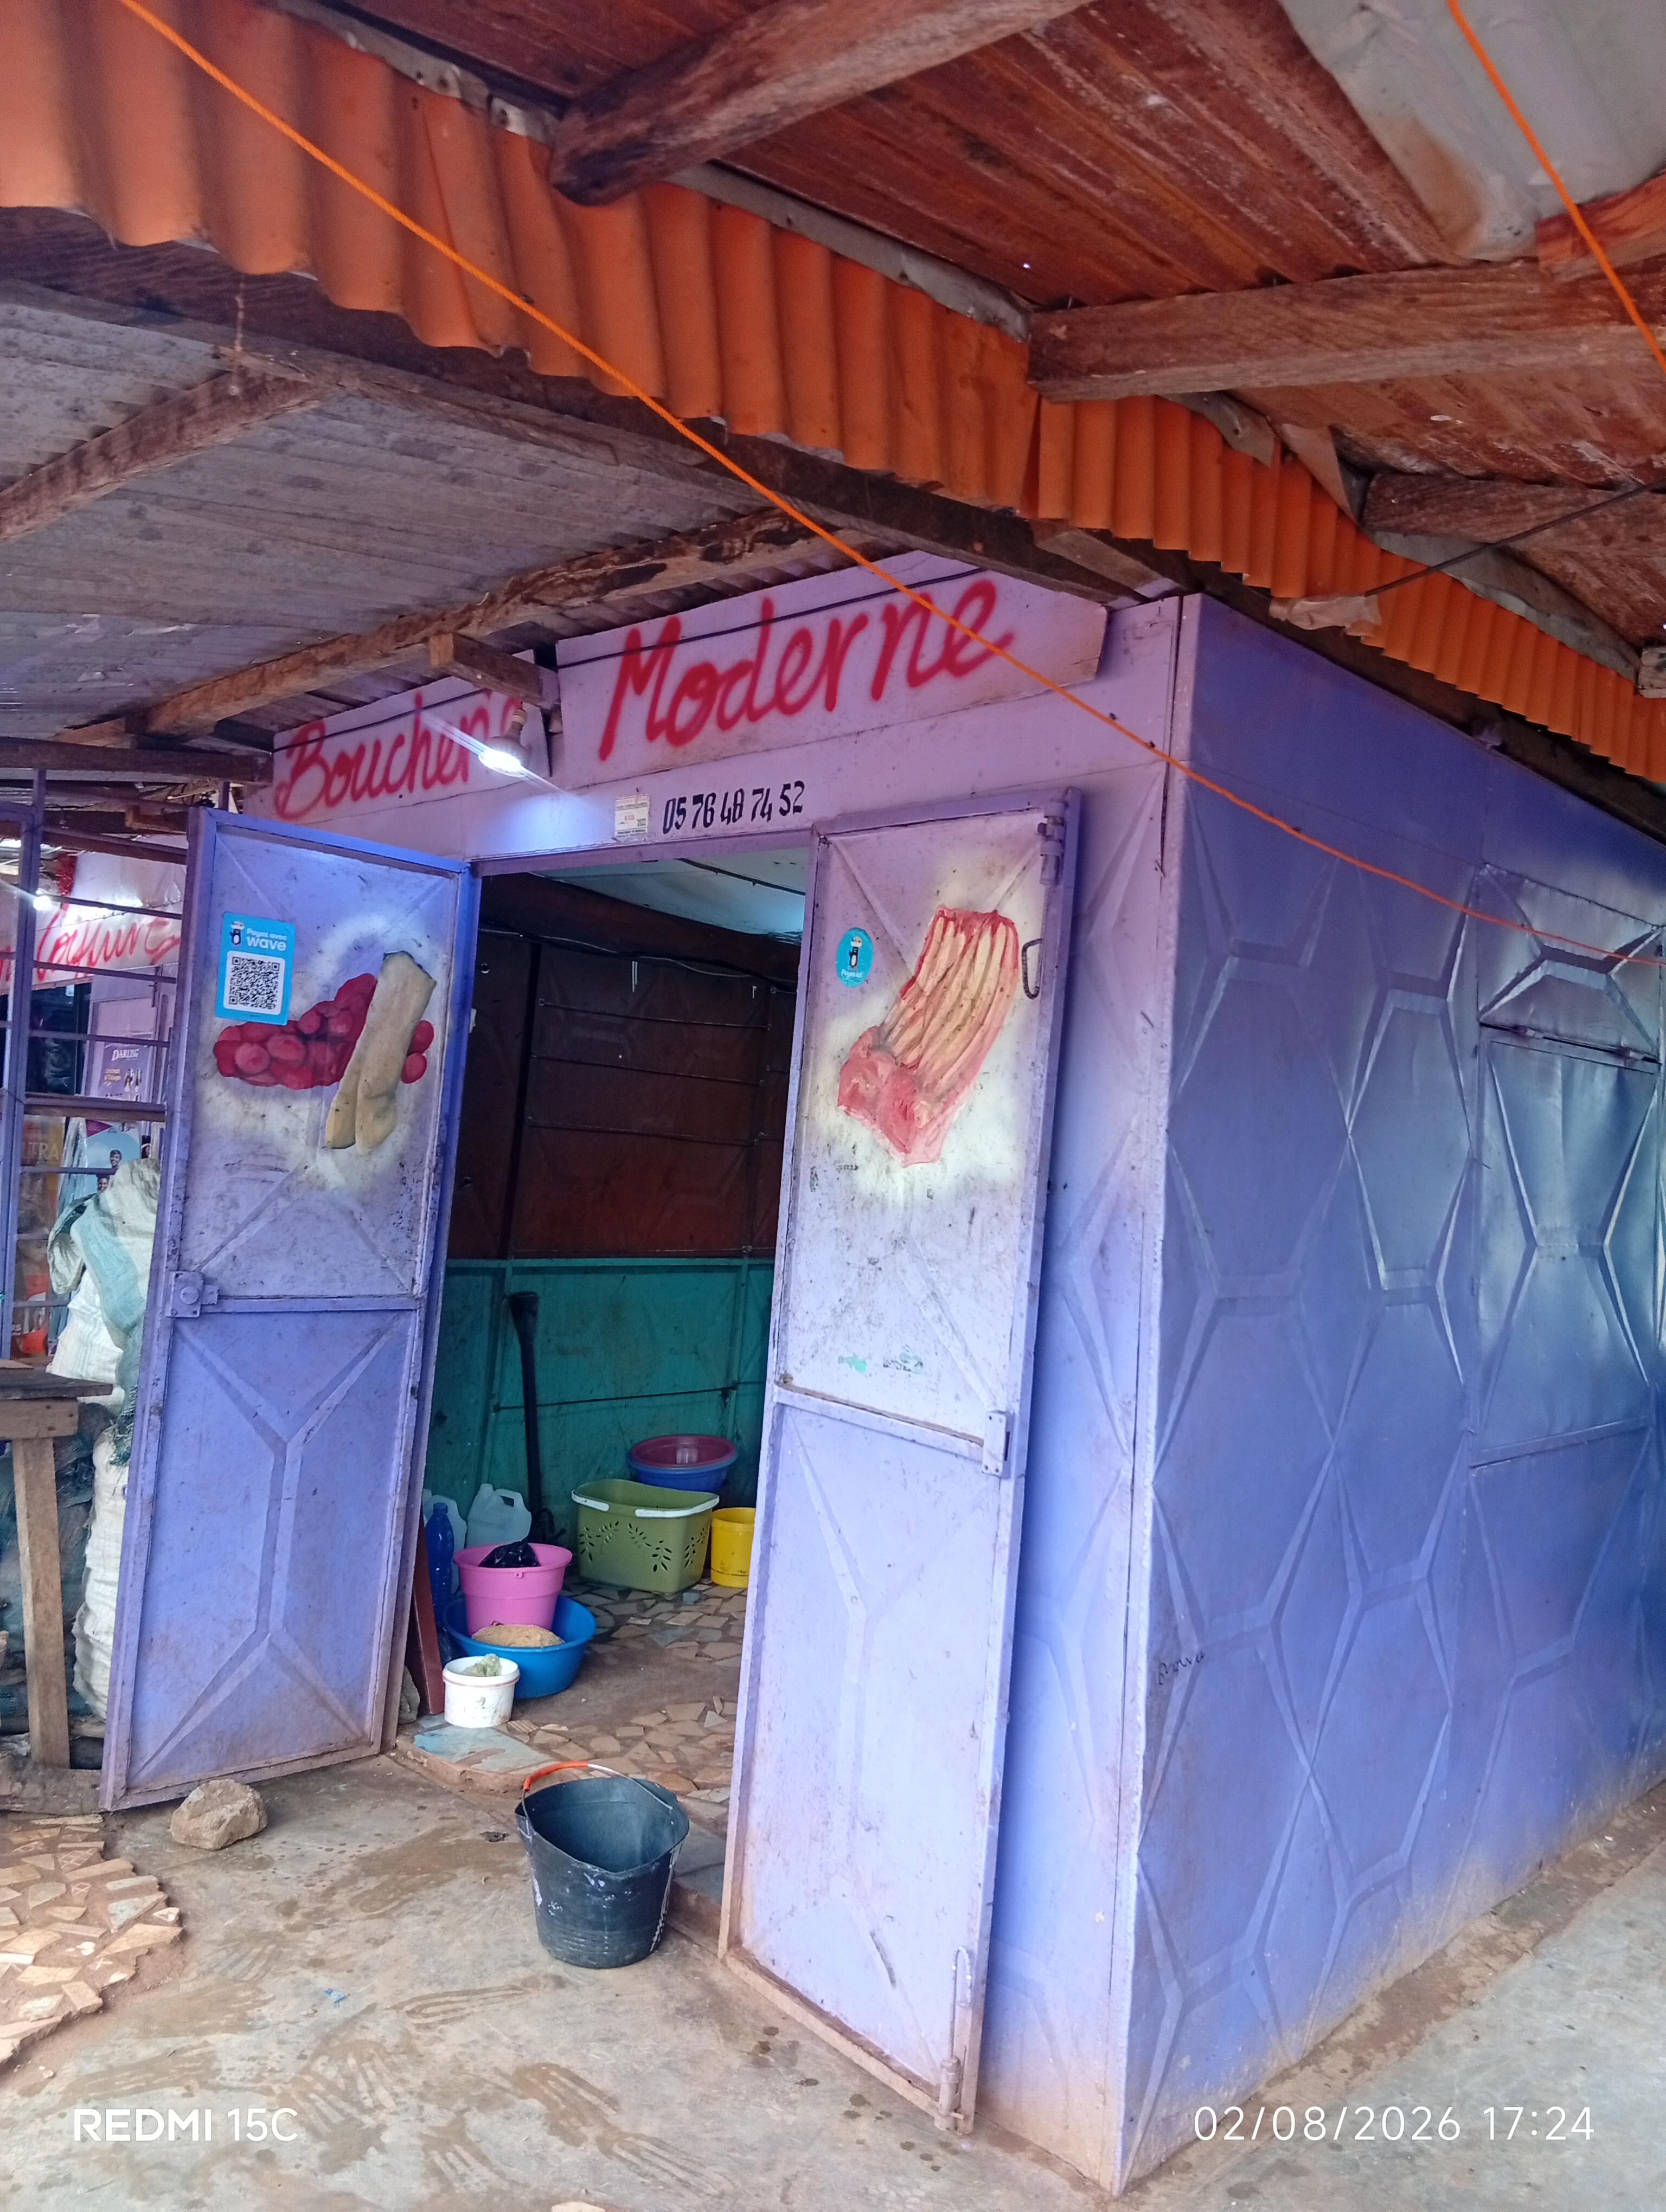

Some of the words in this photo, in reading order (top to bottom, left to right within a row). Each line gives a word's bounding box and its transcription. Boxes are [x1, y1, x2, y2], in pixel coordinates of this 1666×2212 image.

[599, 578, 1015, 762] Moderne
[663, 796, 687, 834] 05
[691, 792, 717, 829] 76
[720, 787, 745, 826] 48
[751, 787, 773, 823] 74
[779, 780, 805, 816] 52
[247, 936, 286, 951] wave
